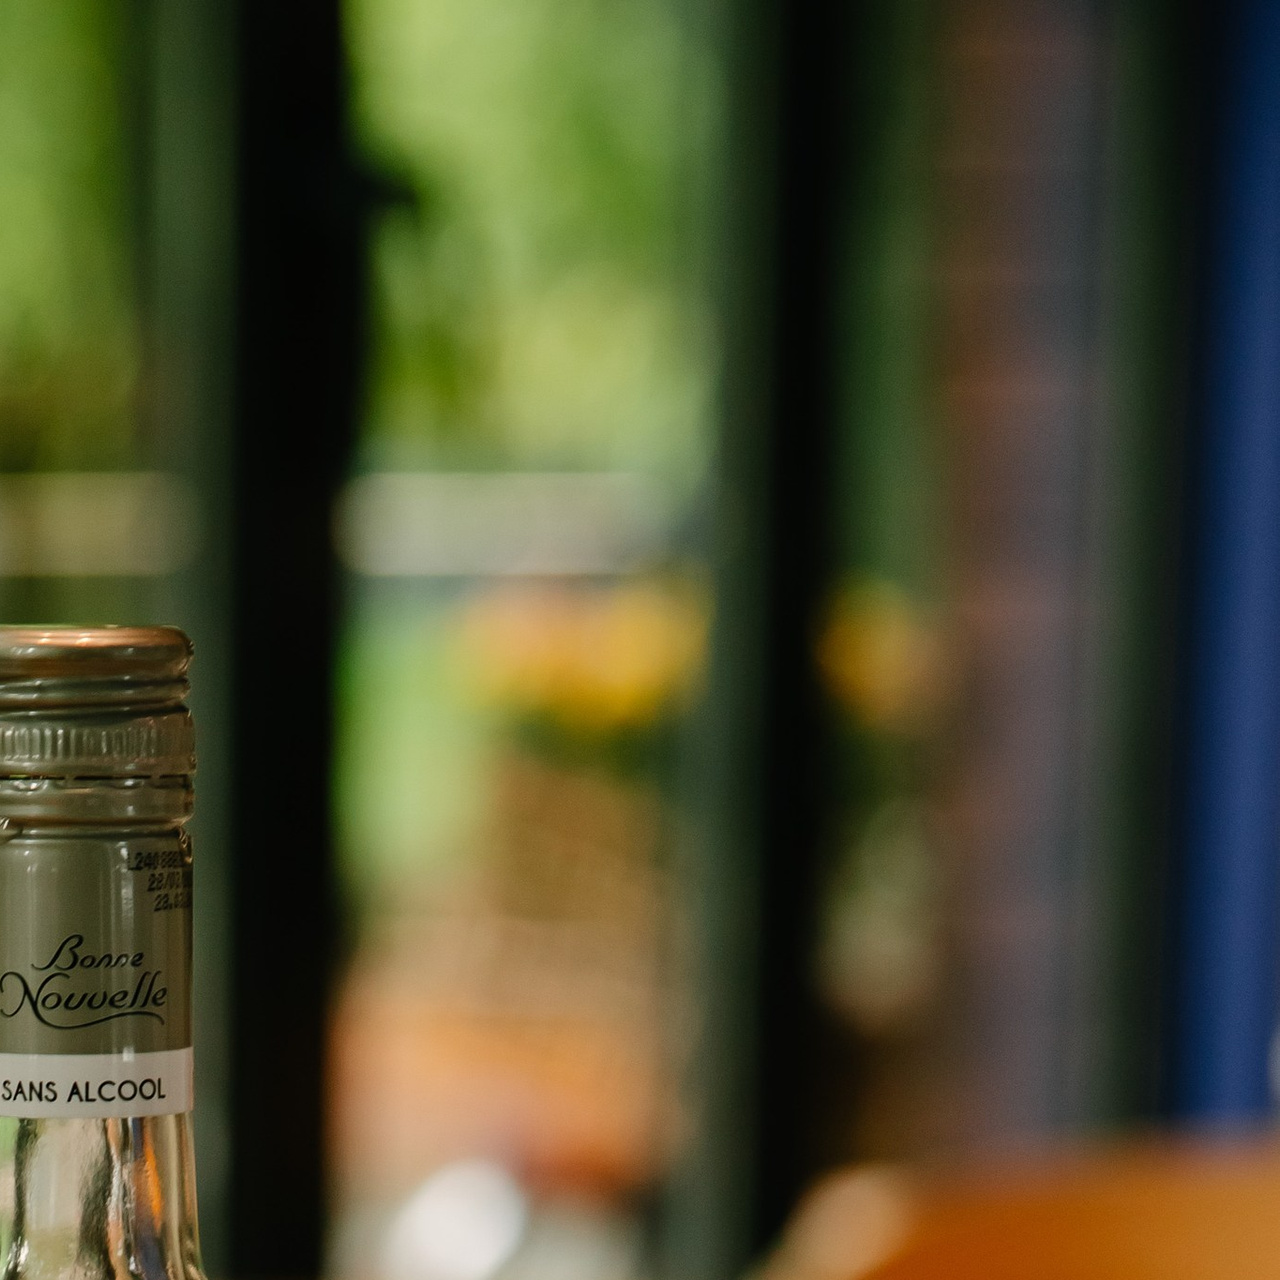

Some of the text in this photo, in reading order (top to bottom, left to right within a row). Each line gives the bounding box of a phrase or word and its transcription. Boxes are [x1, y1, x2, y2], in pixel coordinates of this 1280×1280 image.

[31, 933, 145, 971] Bonne
[0, 970, 168, 1030] Nouvelle
[1, 1077, 166, 1103] SANS ALCOOL
